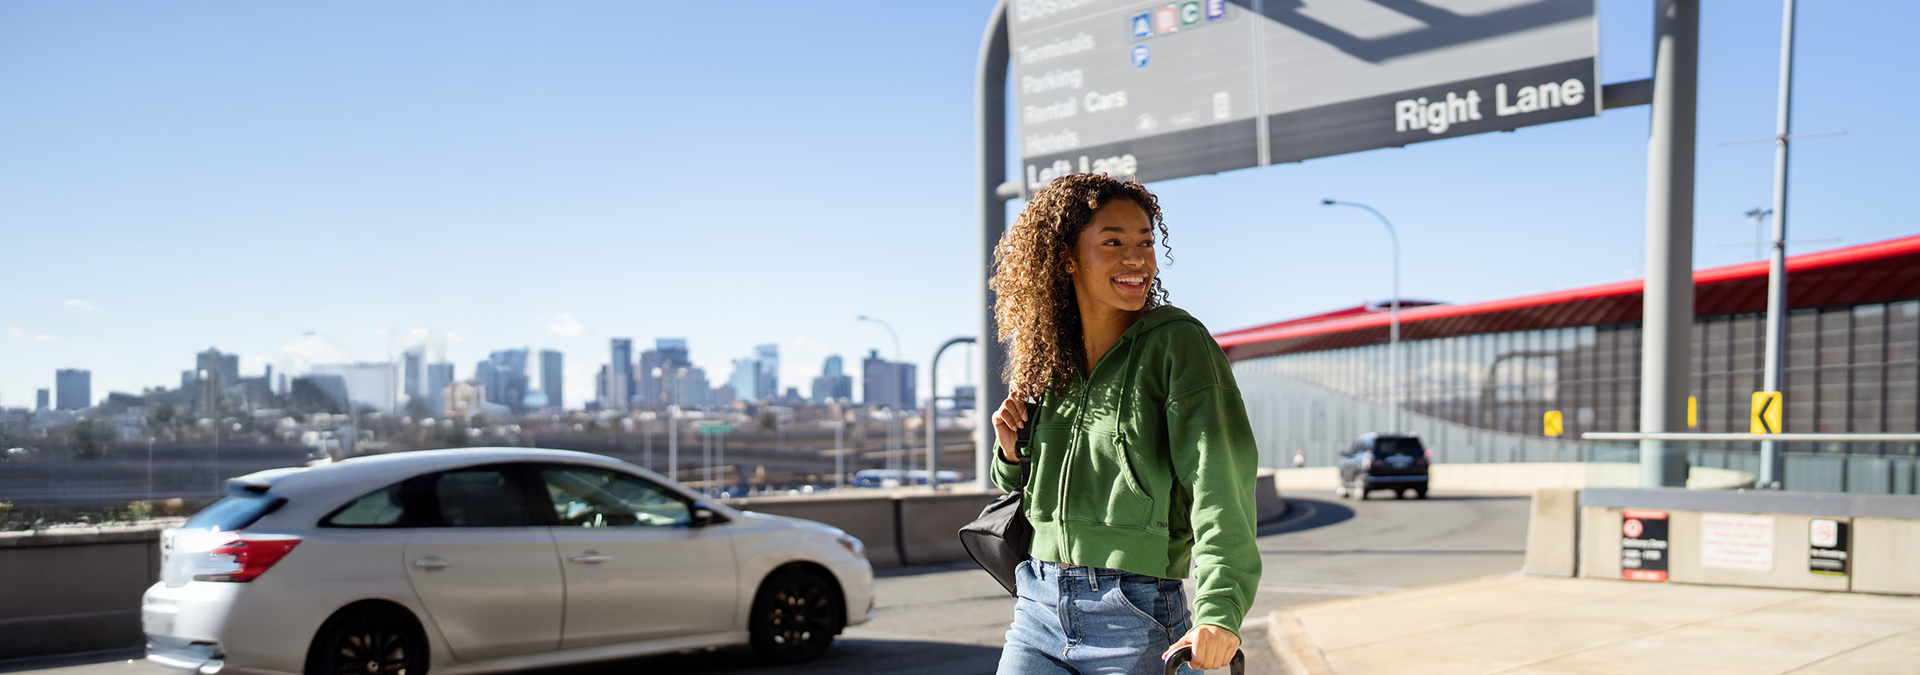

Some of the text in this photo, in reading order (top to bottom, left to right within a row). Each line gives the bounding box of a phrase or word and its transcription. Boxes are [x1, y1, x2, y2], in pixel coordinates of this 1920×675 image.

[1134, 17, 1150, 35] A
[1182, 3, 1200, 23] C
[1207, 0, 1223, 16] E
[1016, 32, 1096, 65] Terminals
[1134, 47, 1150, 67] P
[1021, 68, 1084, 95] Parking
[1023, 91, 1127, 125] Rental Cars
[1395, 78, 1586, 134] Right Lane
